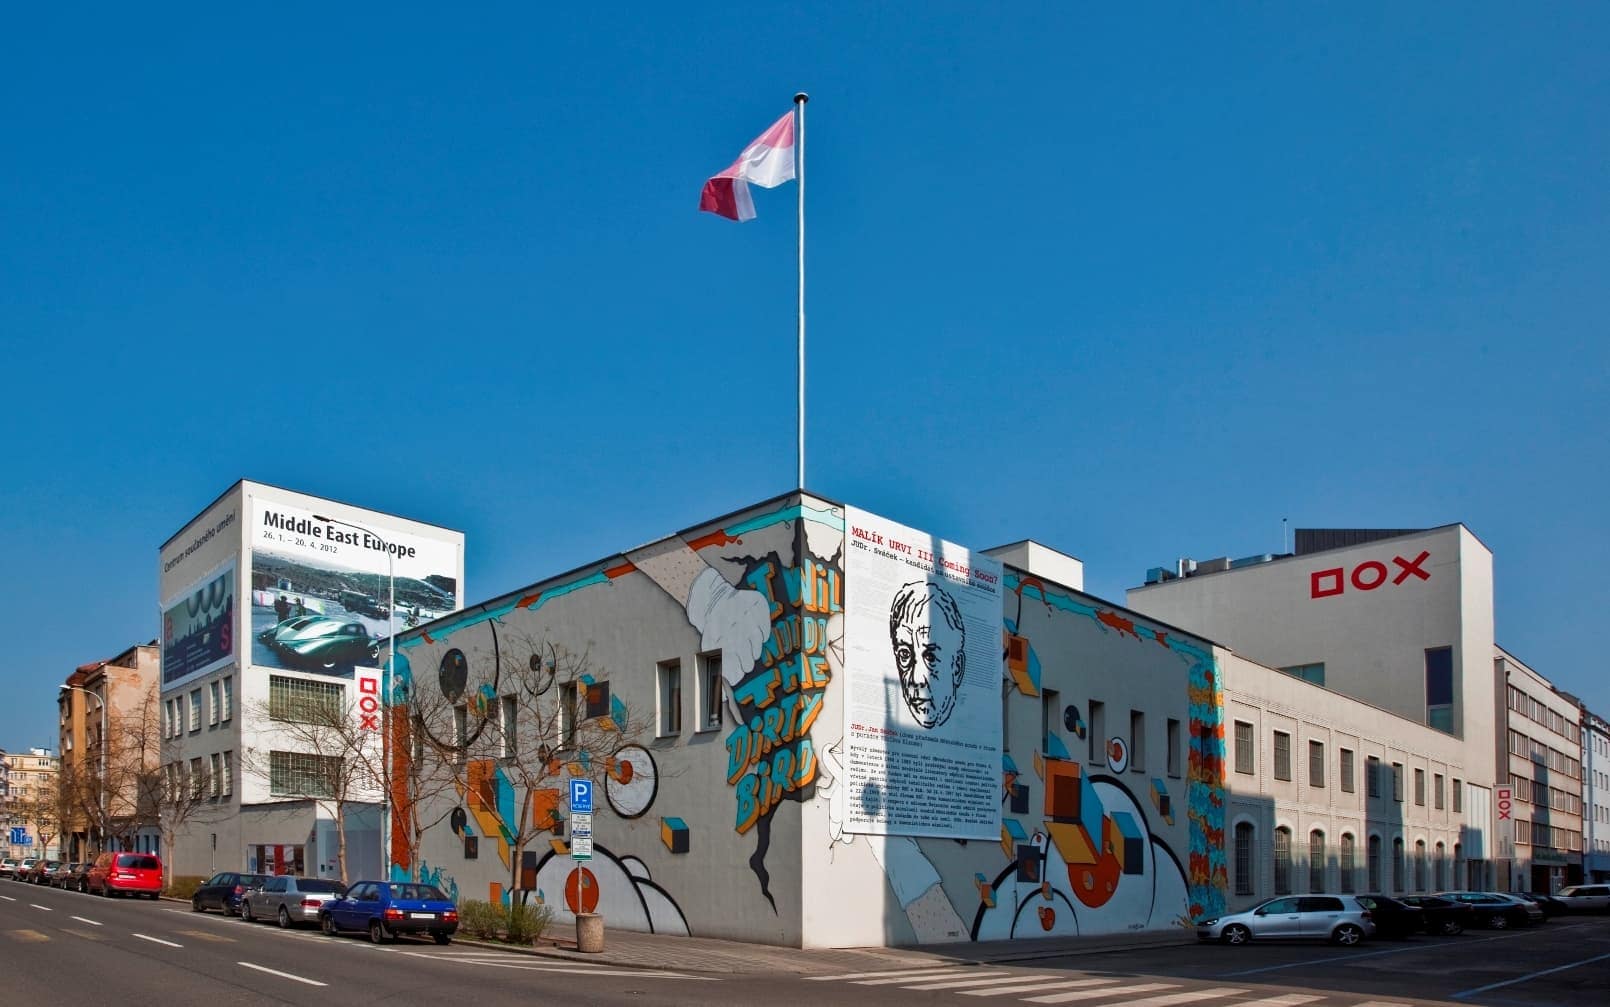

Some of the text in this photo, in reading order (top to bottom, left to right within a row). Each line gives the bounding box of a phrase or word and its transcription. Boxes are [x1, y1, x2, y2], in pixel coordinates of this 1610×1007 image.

[263, 531, 275, 541] 26.
[278, 534, 286, 543] 1.
[295, 537, 307, 548] 20.
[310, 541, 317, 550] 4.
[320, 543, 338, 553] 2012
[264, 510, 416, 559] Middle East Europe
[851, 540, 871, 553] JUDr.
[851, 525, 998, 585] MALÍK URVI III Coming Soon?
[733, 651, 832, 709] THE
[575, 783, 588, 802] P
